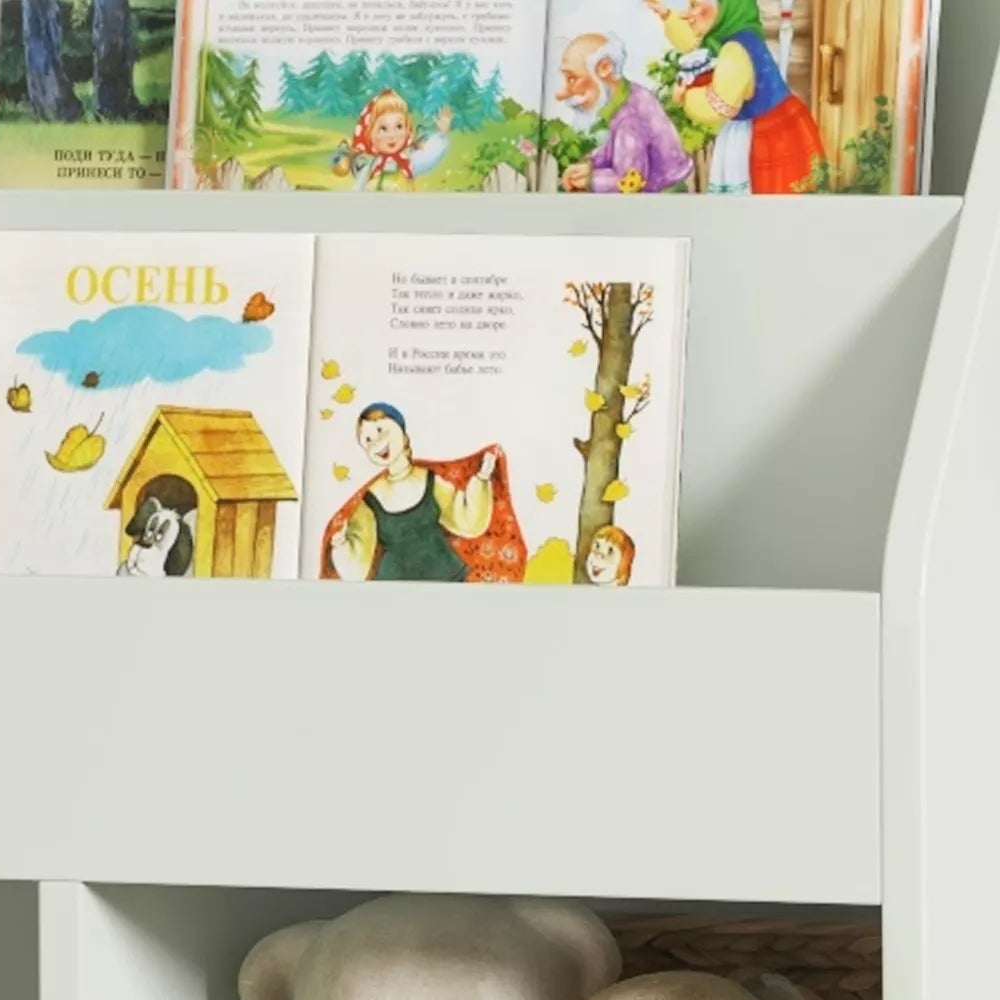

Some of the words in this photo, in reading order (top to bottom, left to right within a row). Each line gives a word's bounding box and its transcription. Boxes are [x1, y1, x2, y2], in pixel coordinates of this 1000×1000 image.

[54, 150, 92, 163] ПОДИ
[98, 150, 134, 163] ТУДА
[57, 167, 122, 179] ПРИНЕСИ
[129, 168, 145, 179] ТО
[66, 264, 229, 305] ОСЕНЬ
